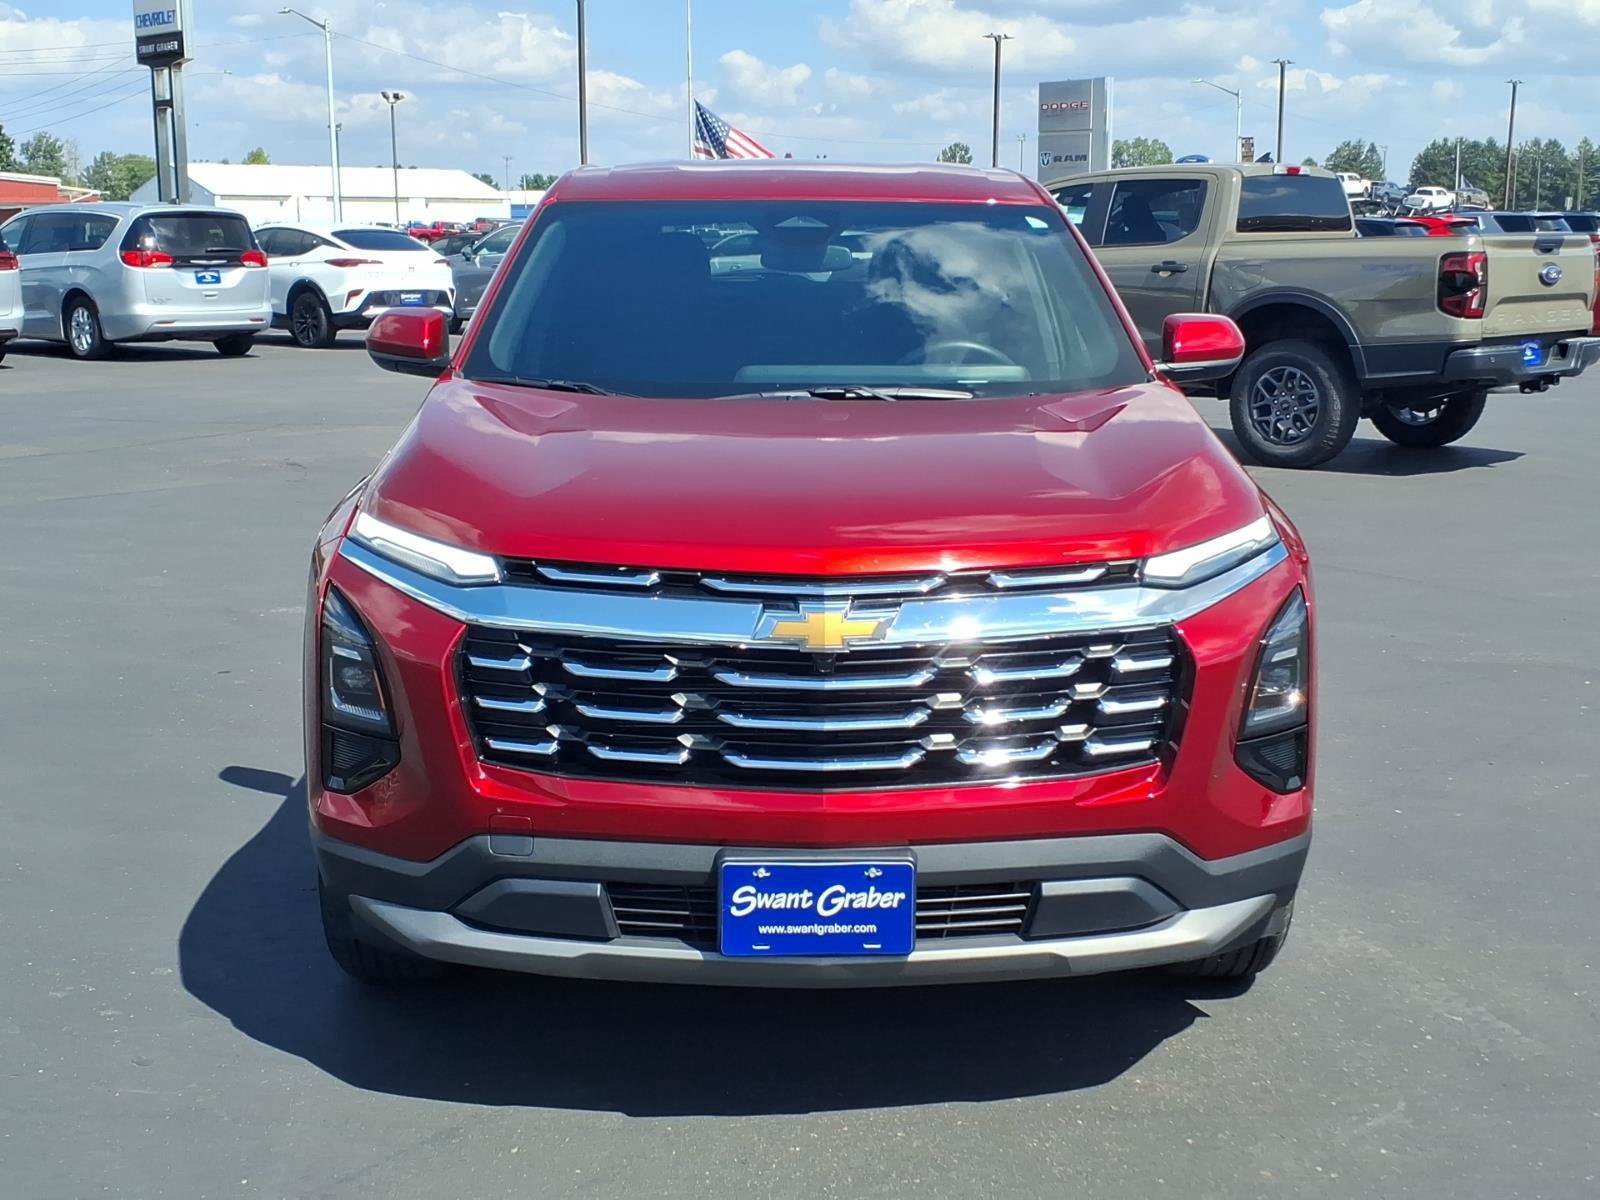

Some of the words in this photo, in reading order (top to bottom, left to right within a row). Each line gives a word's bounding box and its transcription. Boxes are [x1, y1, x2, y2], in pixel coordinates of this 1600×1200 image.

[136, 10, 176, 28] CHEVROLET
[1041, 101, 1088, 111] DODGE
[1053, 154, 1087, 163] RAM
[730, 885, 813, 917] Swant
[816, 885, 905, 917] Graber
[758, 923, 877, 936] www.swantgraber.com
